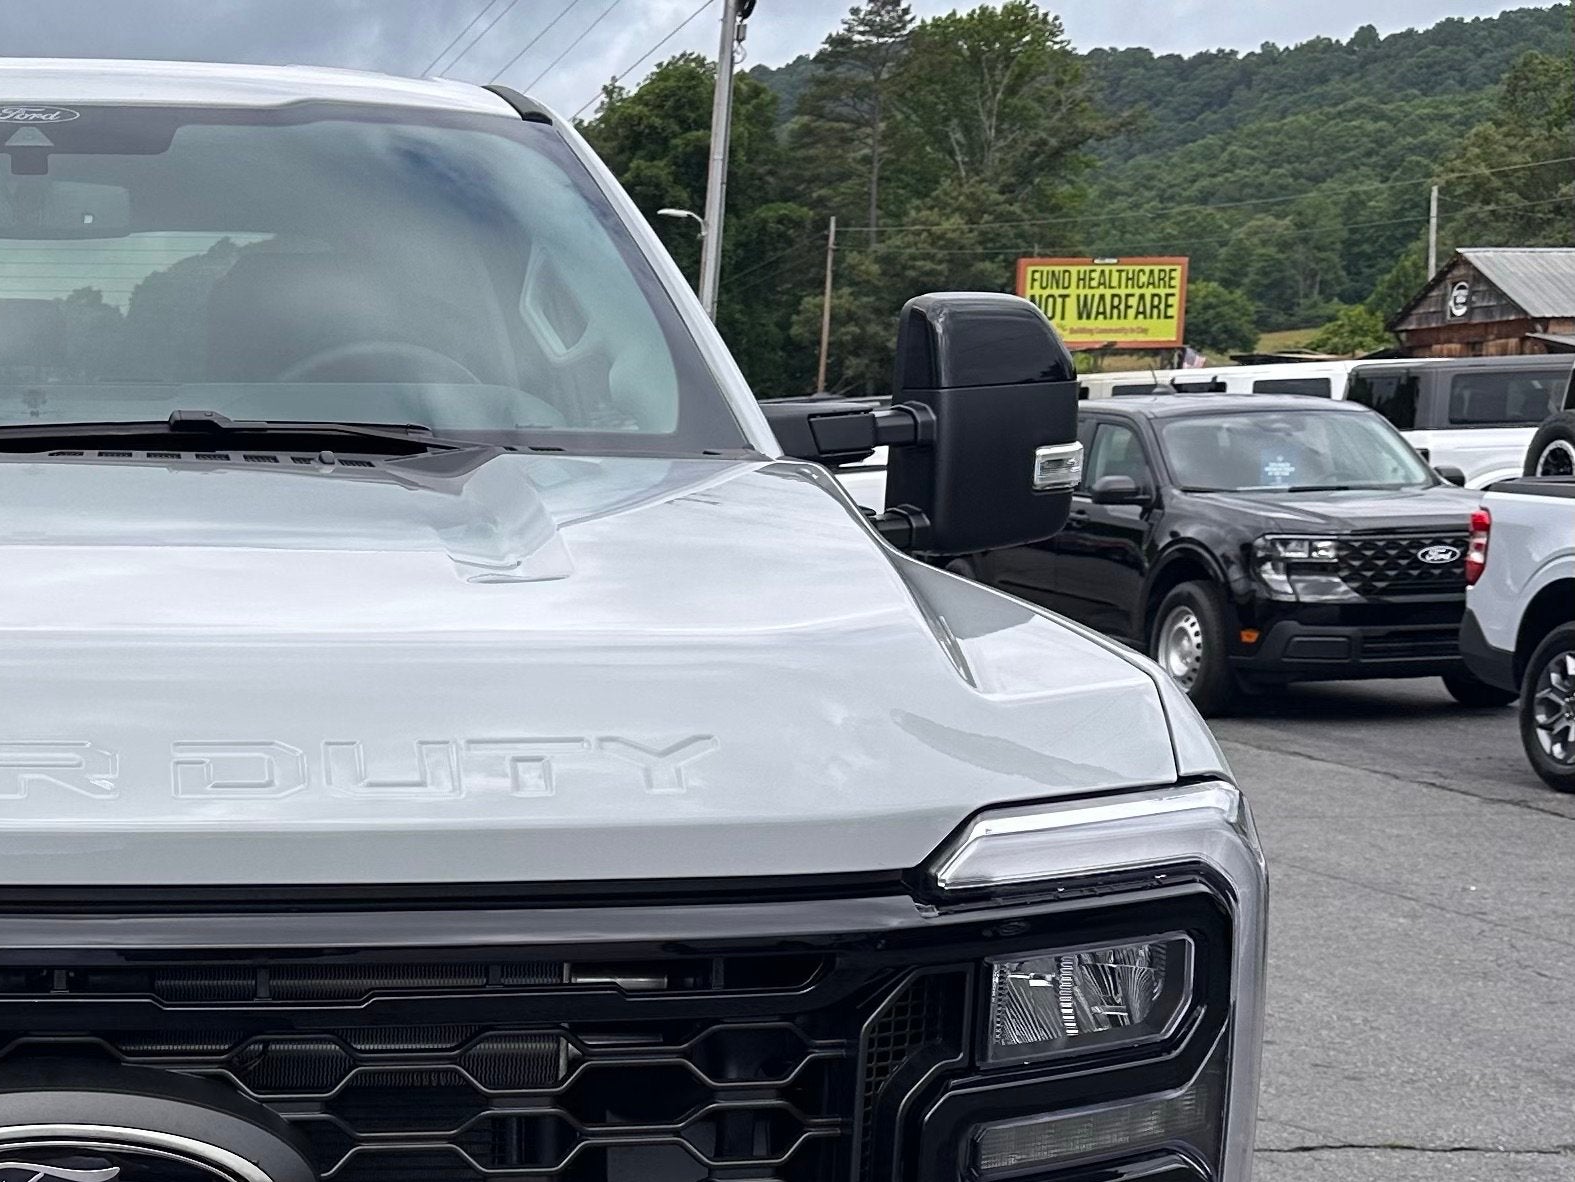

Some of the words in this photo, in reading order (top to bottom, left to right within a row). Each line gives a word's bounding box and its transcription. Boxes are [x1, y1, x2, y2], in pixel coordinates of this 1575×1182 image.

[1030, 269, 1072, 290] FUND
[1076, 268, 1177, 289] HEALTHCARE
[1076, 293, 1176, 321] WARFARE
[169, 733, 721, 799] DUTY
